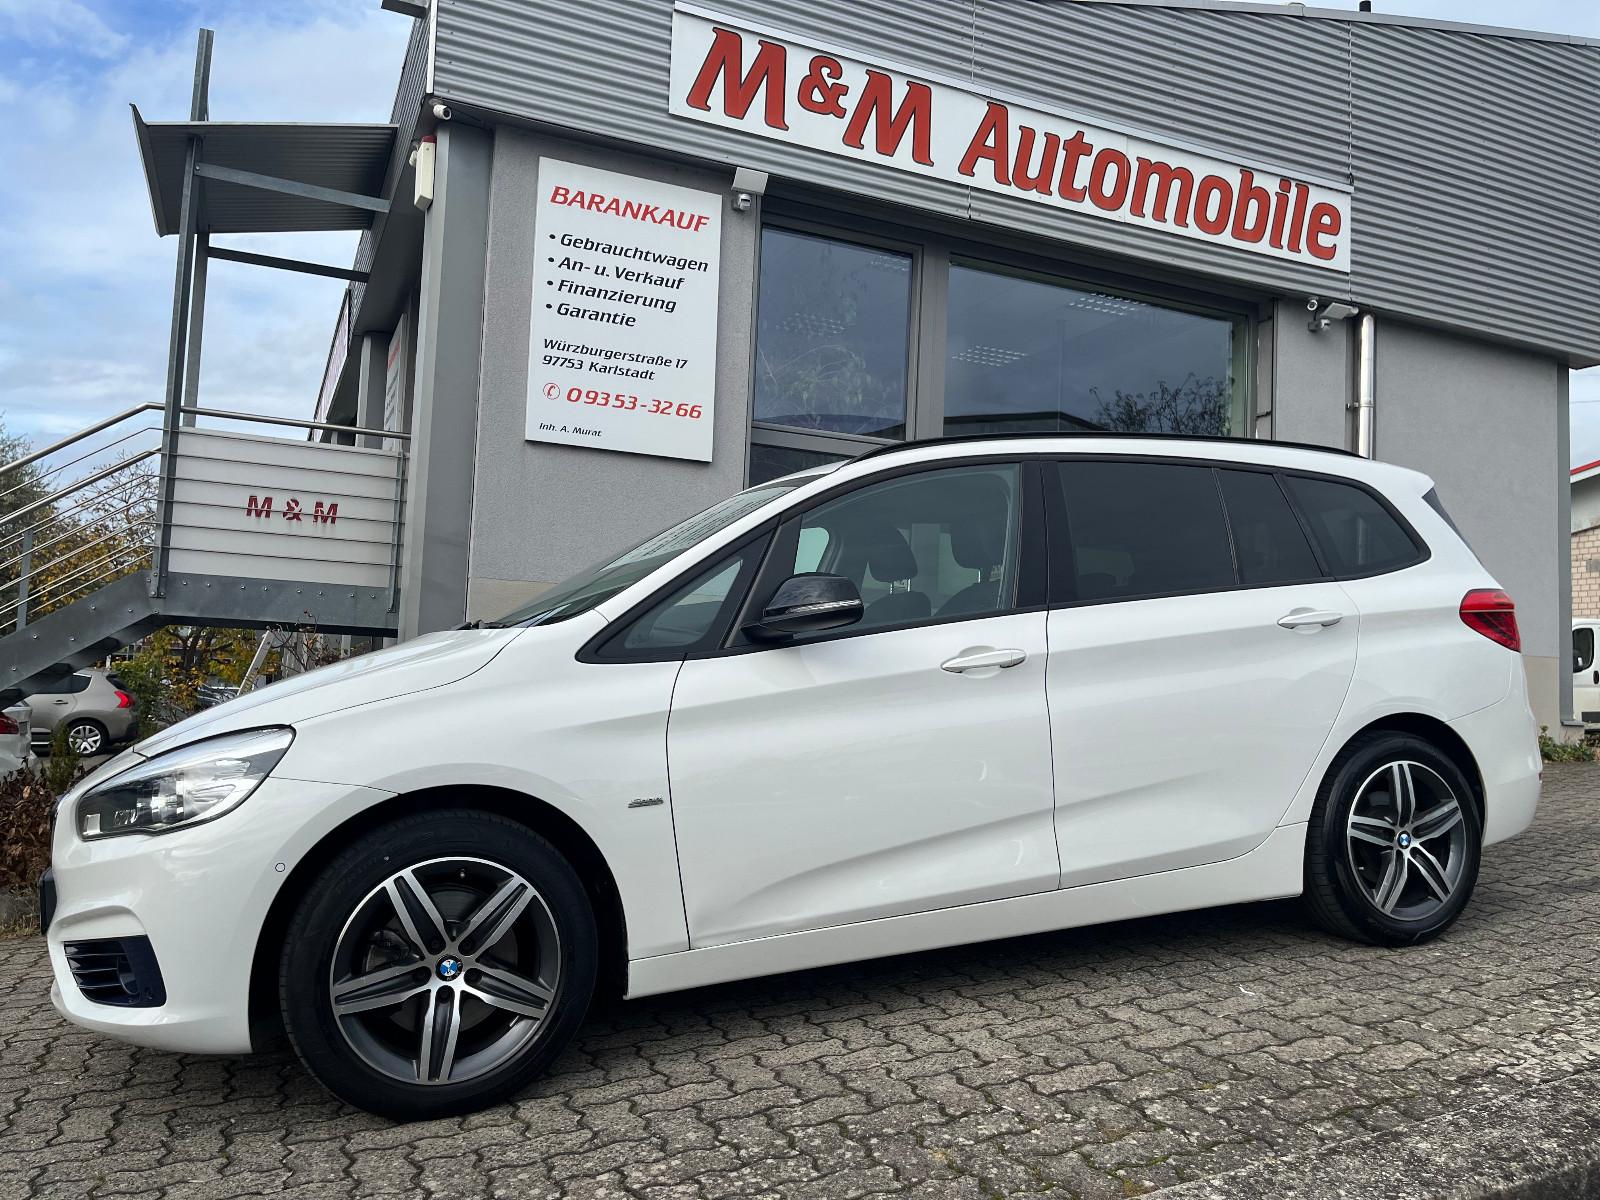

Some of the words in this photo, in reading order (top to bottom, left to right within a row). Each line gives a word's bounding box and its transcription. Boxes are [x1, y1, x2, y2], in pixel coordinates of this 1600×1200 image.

[957, 100, 1341, 261] Automobile
[550, 185, 710, 232] BARANKAUF
[560, 233, 709, 273] Gebrauchtwagen
[558, 256, 591, 272] An-
[594, 264, 610, 278] u.
[614, 266, 685, 290] Verkauf
[557, 279, 677, 313] Finanzierung
[556, 302, 637, 327] Garantie
[542, 354, 584, 371] 97753
[588, 361, 656, 381] Karlstadt
[543, 338, 673, 368] Würzburgerstraße
[675, 358, 688, 369] 17
[539, 422, 557, 432] Inh.
[560, 425, 570, 433] A.
[572, 426, 602, 437] Murat
[246, 495, 273, 519] M
[312, 501, 339, 525] M
